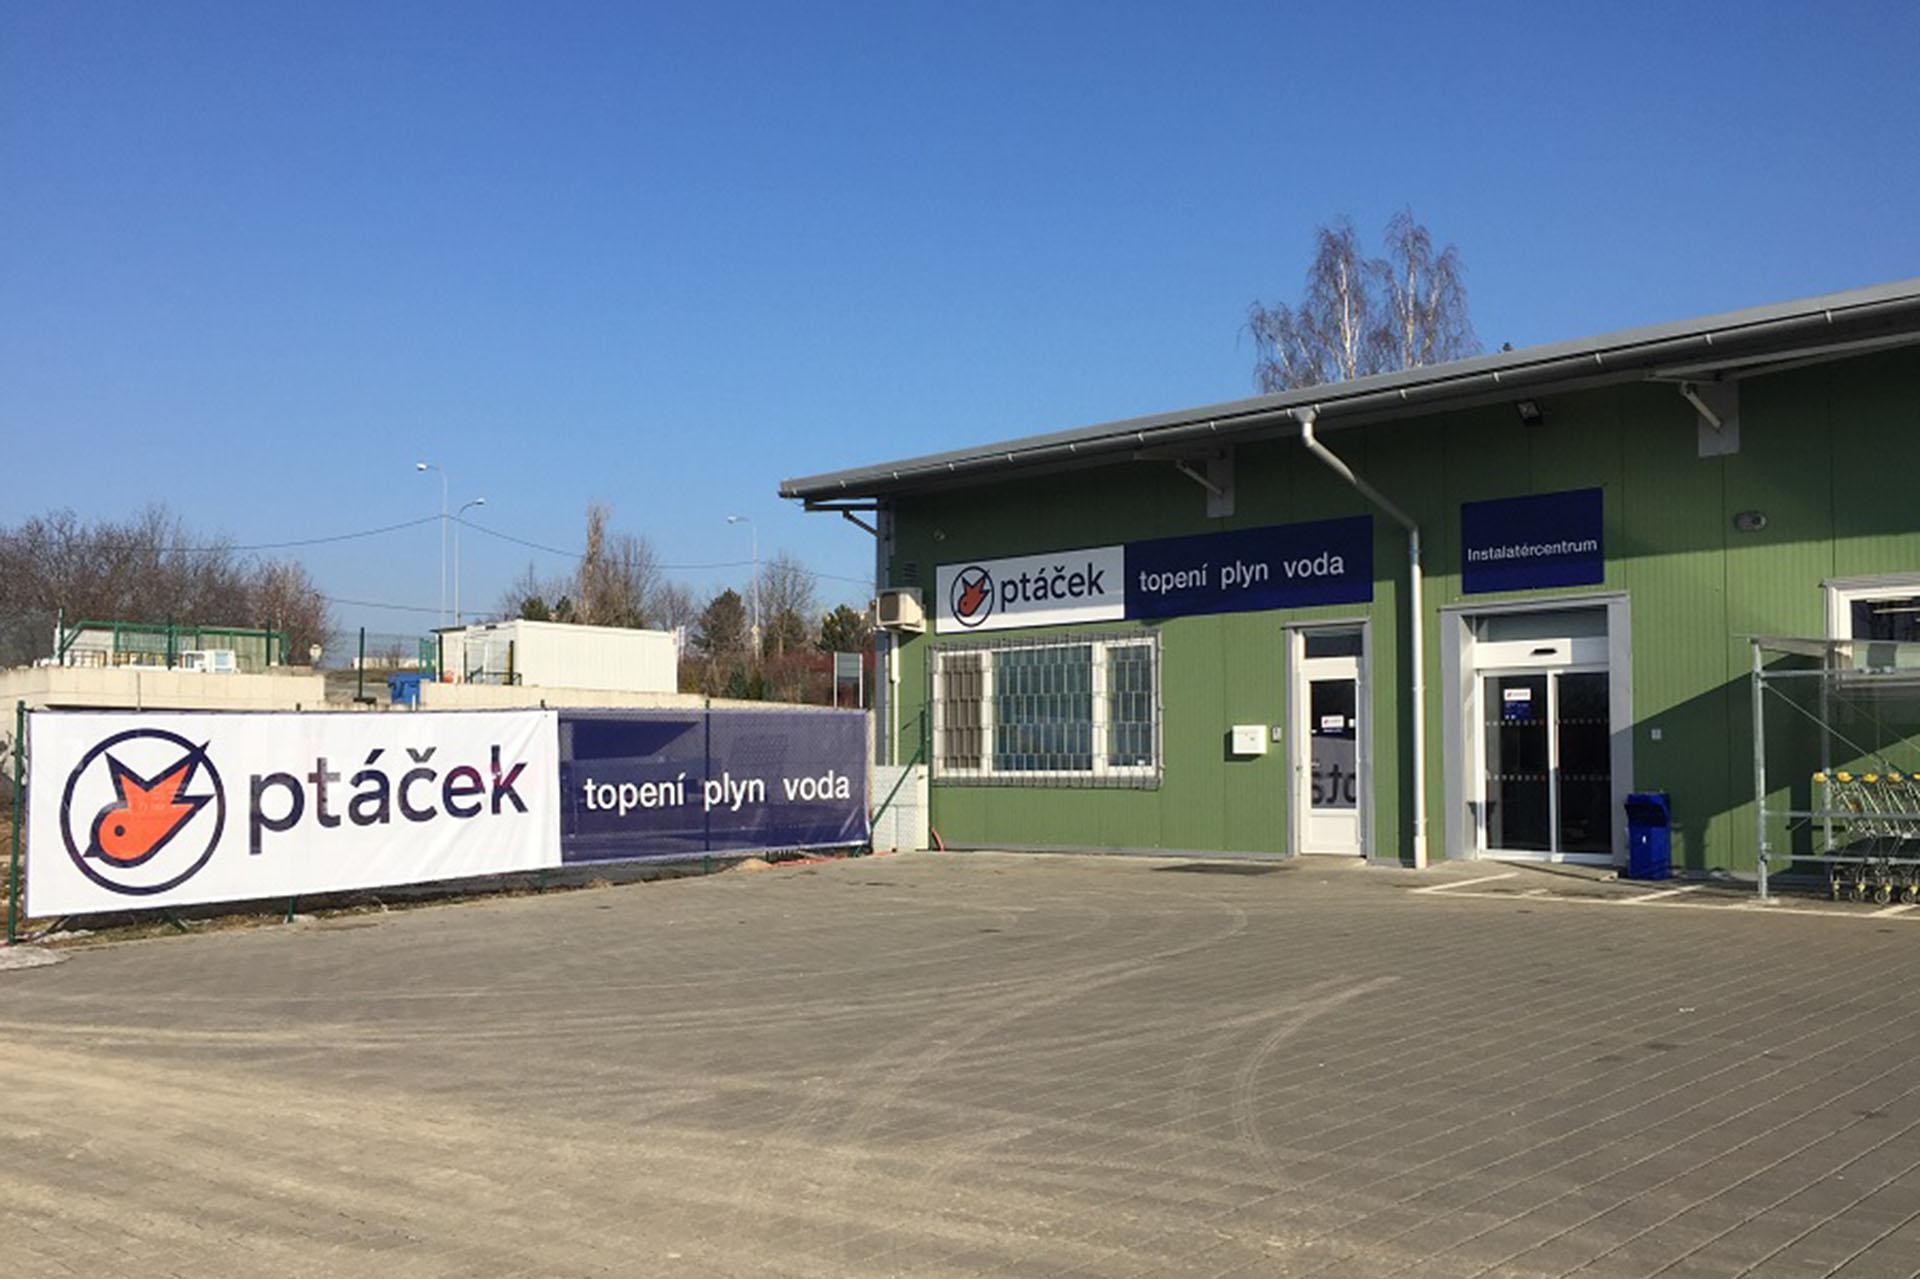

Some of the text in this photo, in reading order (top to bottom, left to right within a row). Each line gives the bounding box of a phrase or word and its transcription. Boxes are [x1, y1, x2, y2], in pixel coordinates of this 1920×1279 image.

[1467, 539, 1597, 562] Instalatércentrum
[1000, 552, 1344, 613] ptáček topení plyn voda
[249, 745, 850, 855] ptáček topení plyn voda
